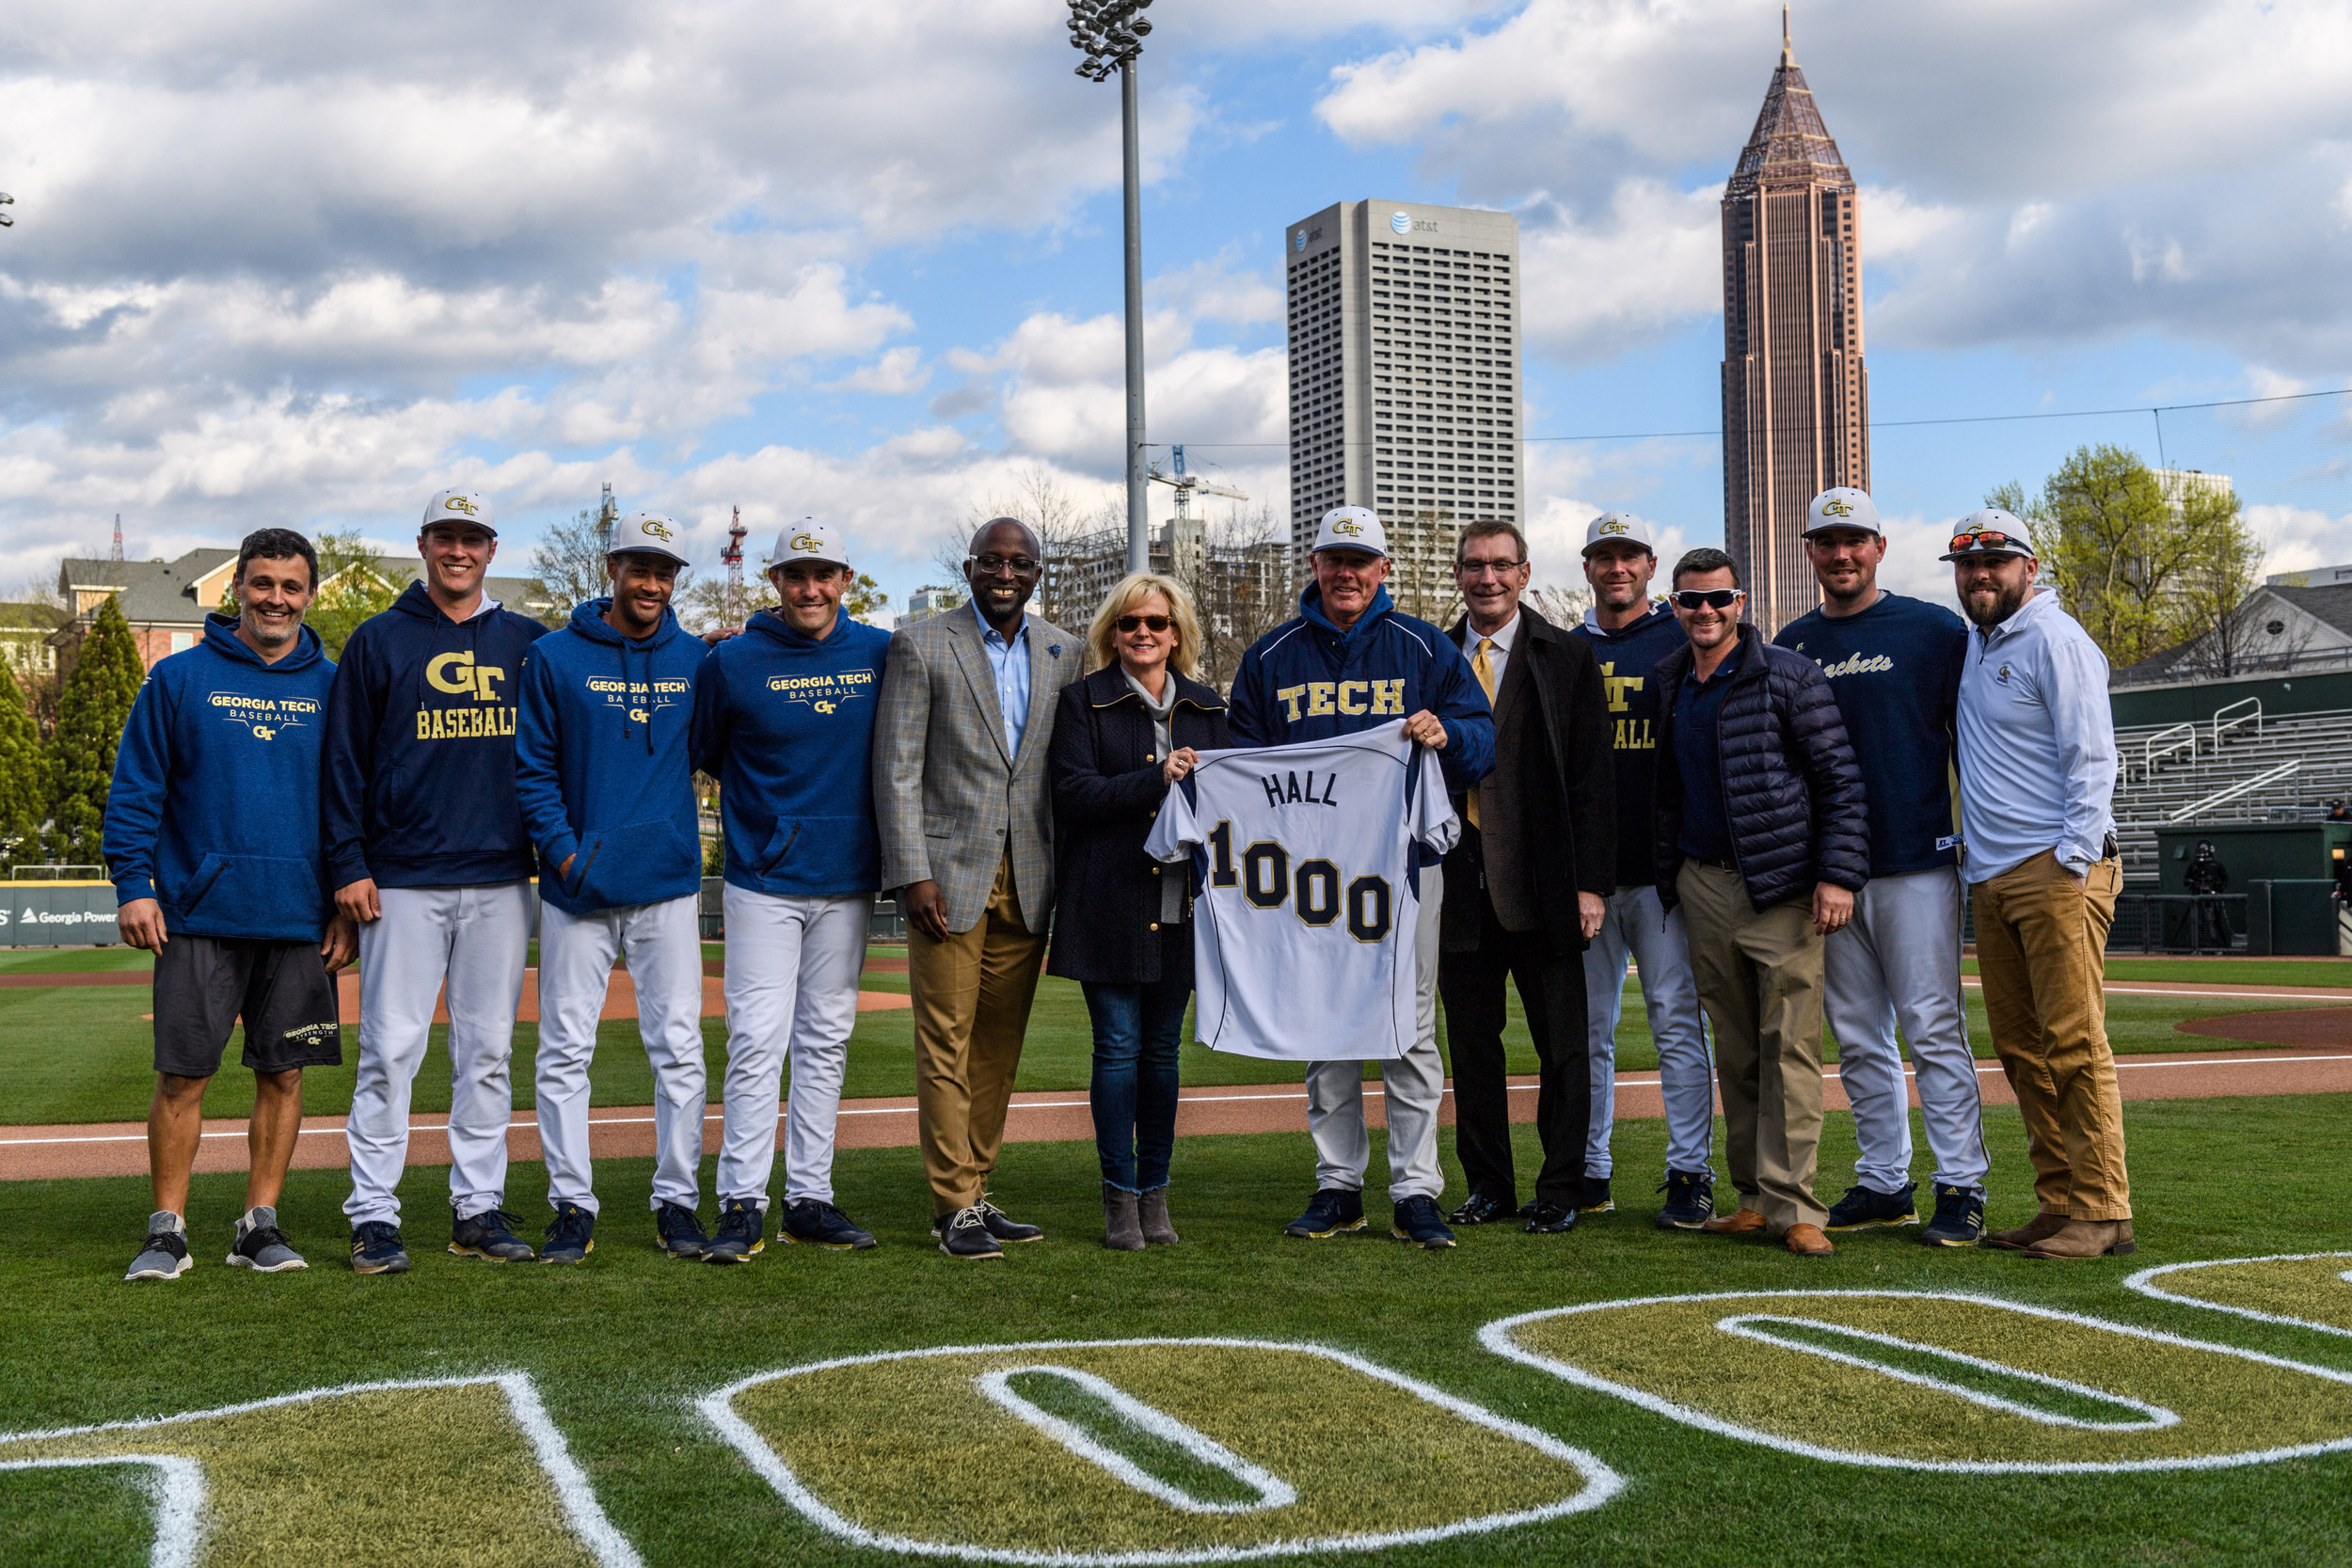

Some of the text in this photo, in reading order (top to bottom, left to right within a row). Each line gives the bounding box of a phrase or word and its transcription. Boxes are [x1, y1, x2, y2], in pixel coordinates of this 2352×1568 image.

[1413, 220, 1438, 233] at&t
[445, 496, 479, 516] GT
[1820, 499, 1853, 516] GT
[642, 520, 673, 542] GT
[1332, 518, 1364, 537] GT
[1599, 518, 1629, 534] GT
[790, 532, 823, 553] GT
[1815, 651, 1894, 678] ackets
[425, 650, 505, 701] GT
[771, 673, 872, 691] GEORGIA TECH
[590, 680, 686, 694] GEORGIA TECH
[789, 687, 857, 699] BASEBALL
[212, 695, 316, 714] GEORGIA TECH
[607, 694, 671, 705] BAEBLL
[814, 700, 836, 714] GT
[1277, 678, 1406, 723] TECH
[230, 709, 298, 722] BASEBALL
[628, 708, 650, 723] GT
[252, 725, 276, 741] GT
[1261, 769, 1338, 808] HALL
[1208, 819, 1392, 943] 1000
[39, 911, 118, 926] Georgia Power
[320, 1022, 338, 1031] TEC
